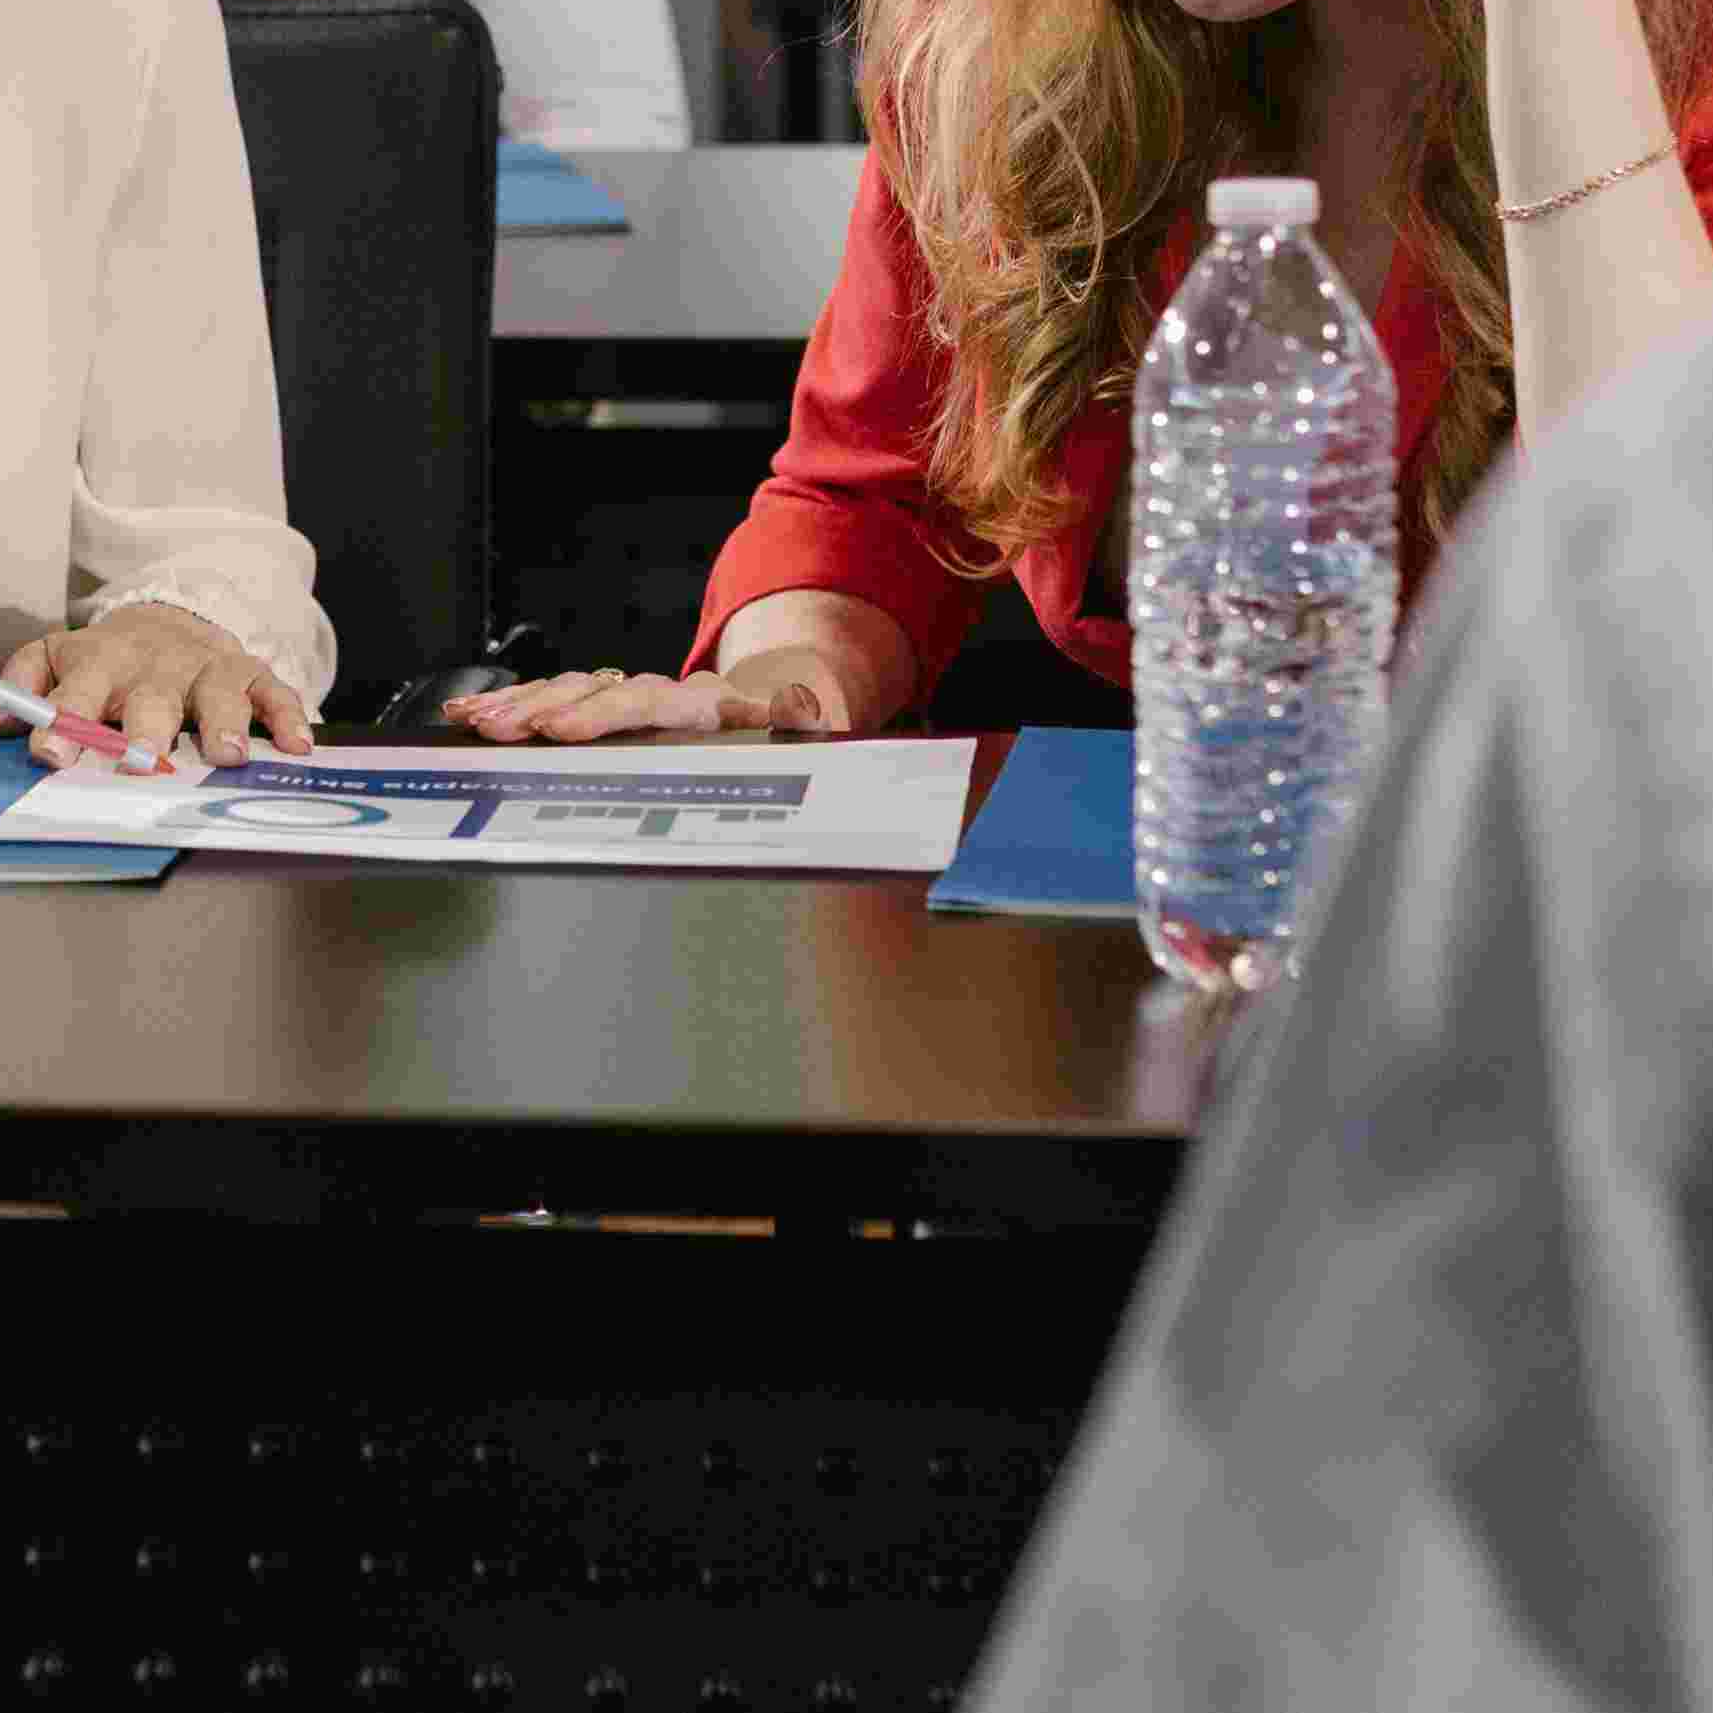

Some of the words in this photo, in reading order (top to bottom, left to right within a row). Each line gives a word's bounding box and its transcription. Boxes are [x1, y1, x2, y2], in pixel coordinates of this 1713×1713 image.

[257, 774, 368, 791] Skills
[382, 780, 532, 793] Graphs
[639, 785, 776, 798] Charts
